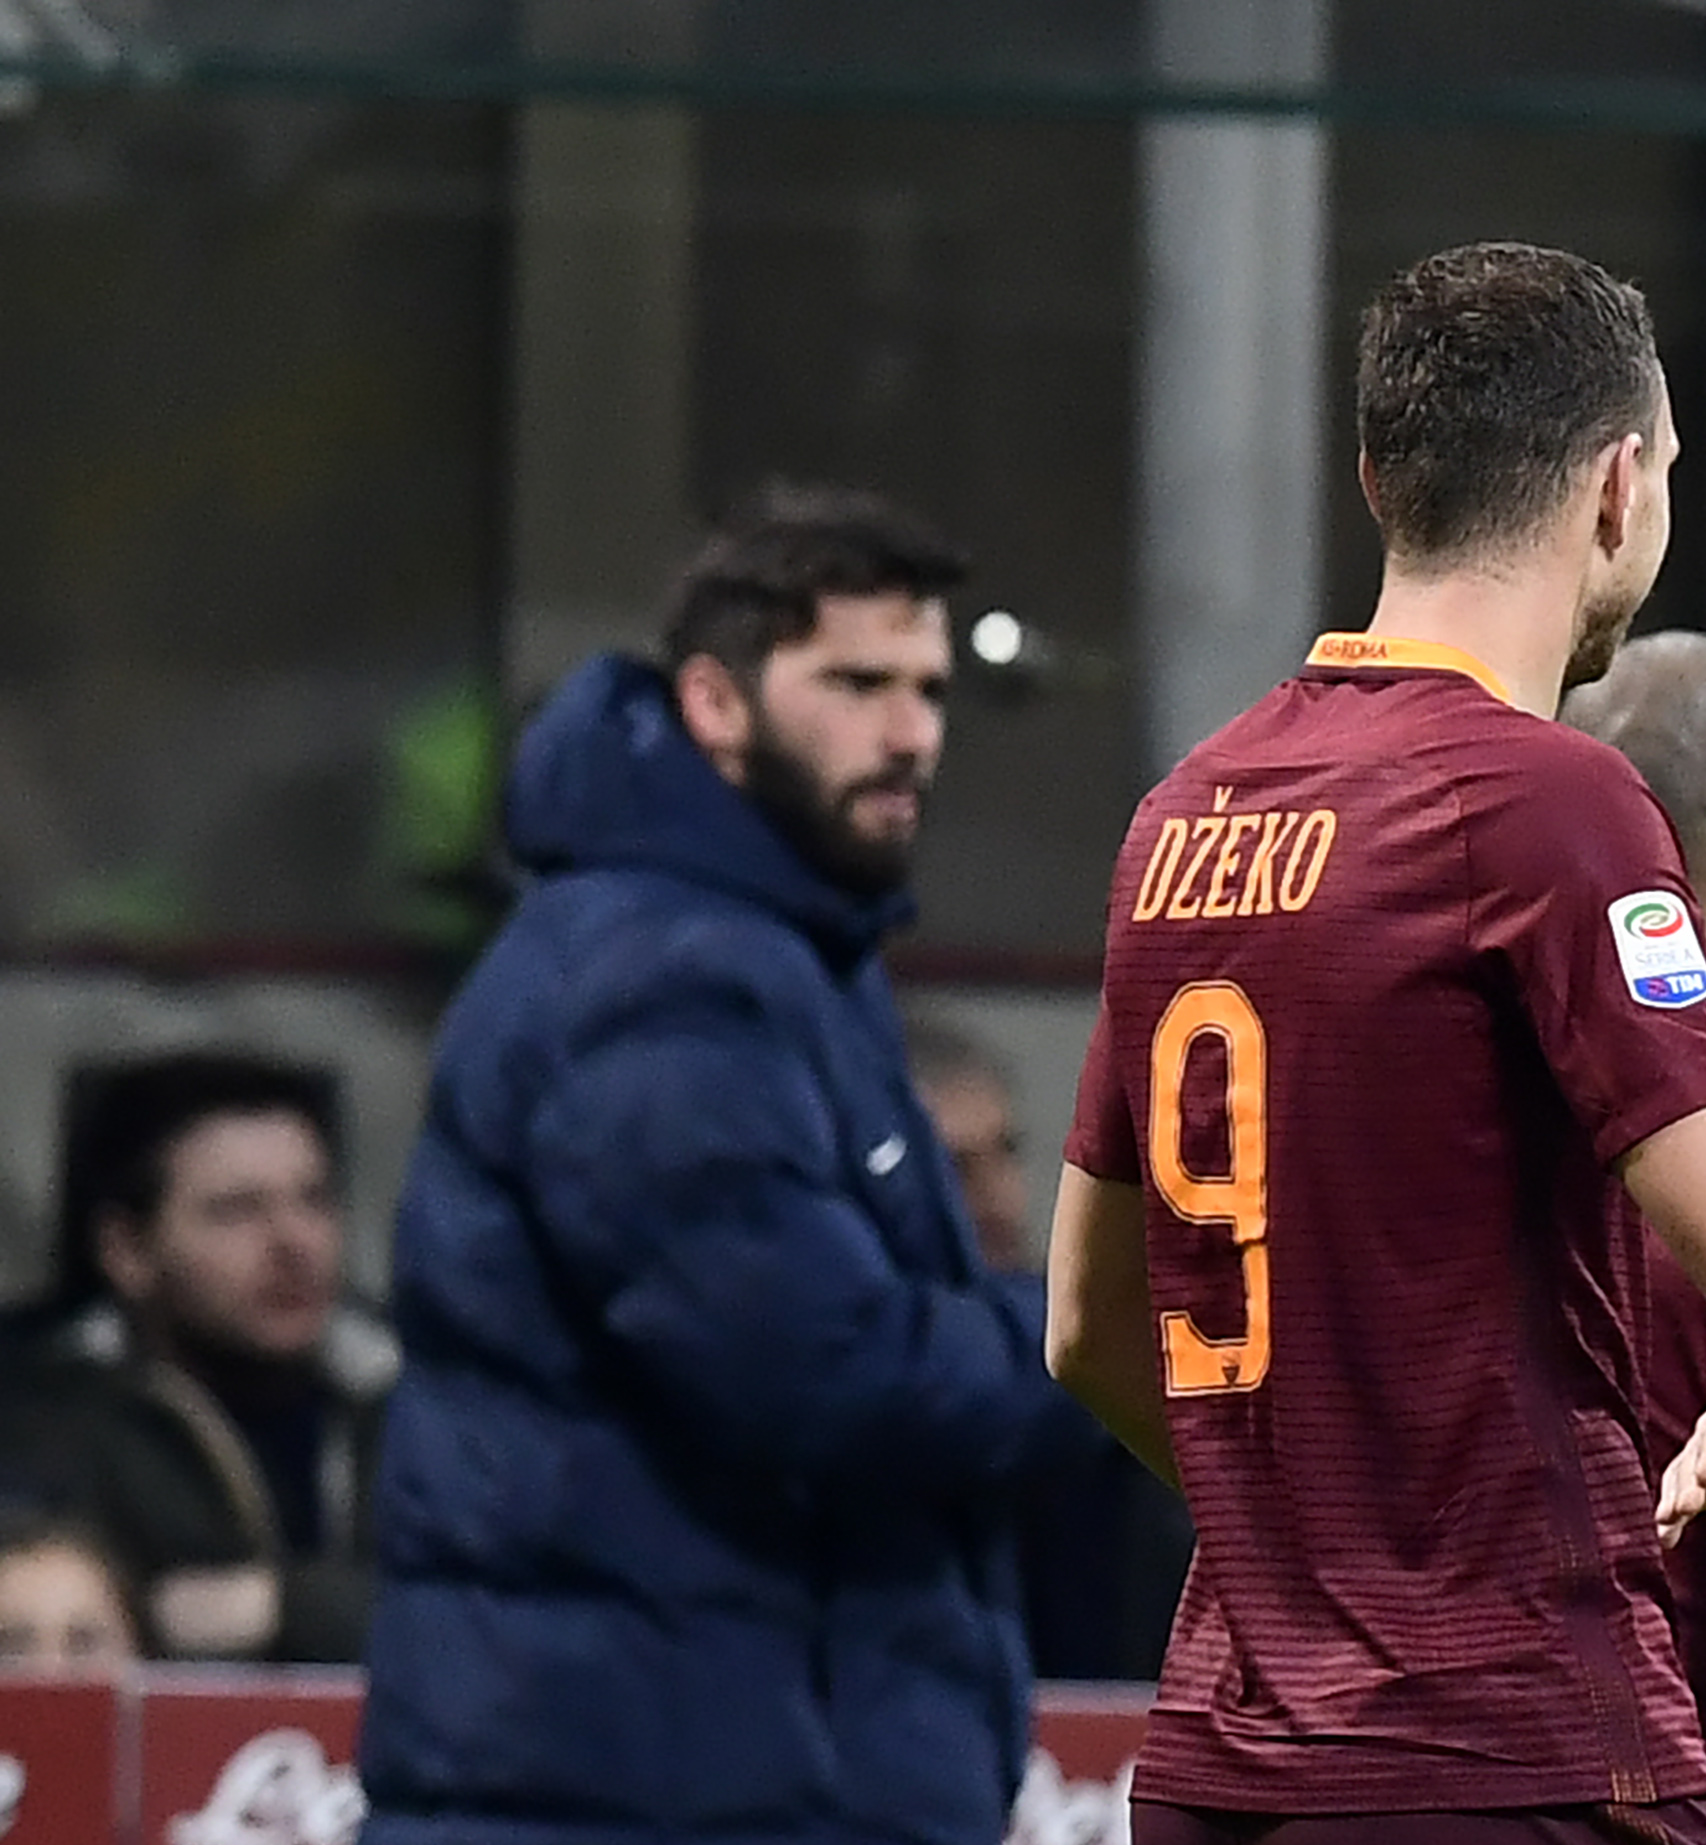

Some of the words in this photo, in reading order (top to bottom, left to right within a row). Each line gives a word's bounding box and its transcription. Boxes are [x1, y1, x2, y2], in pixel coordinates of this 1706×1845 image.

[1132, 786, 1337, 923] DŽEKO
[1666, 973, 1704, 995] TIM
[1150, 980, 1271, 1397] 9
